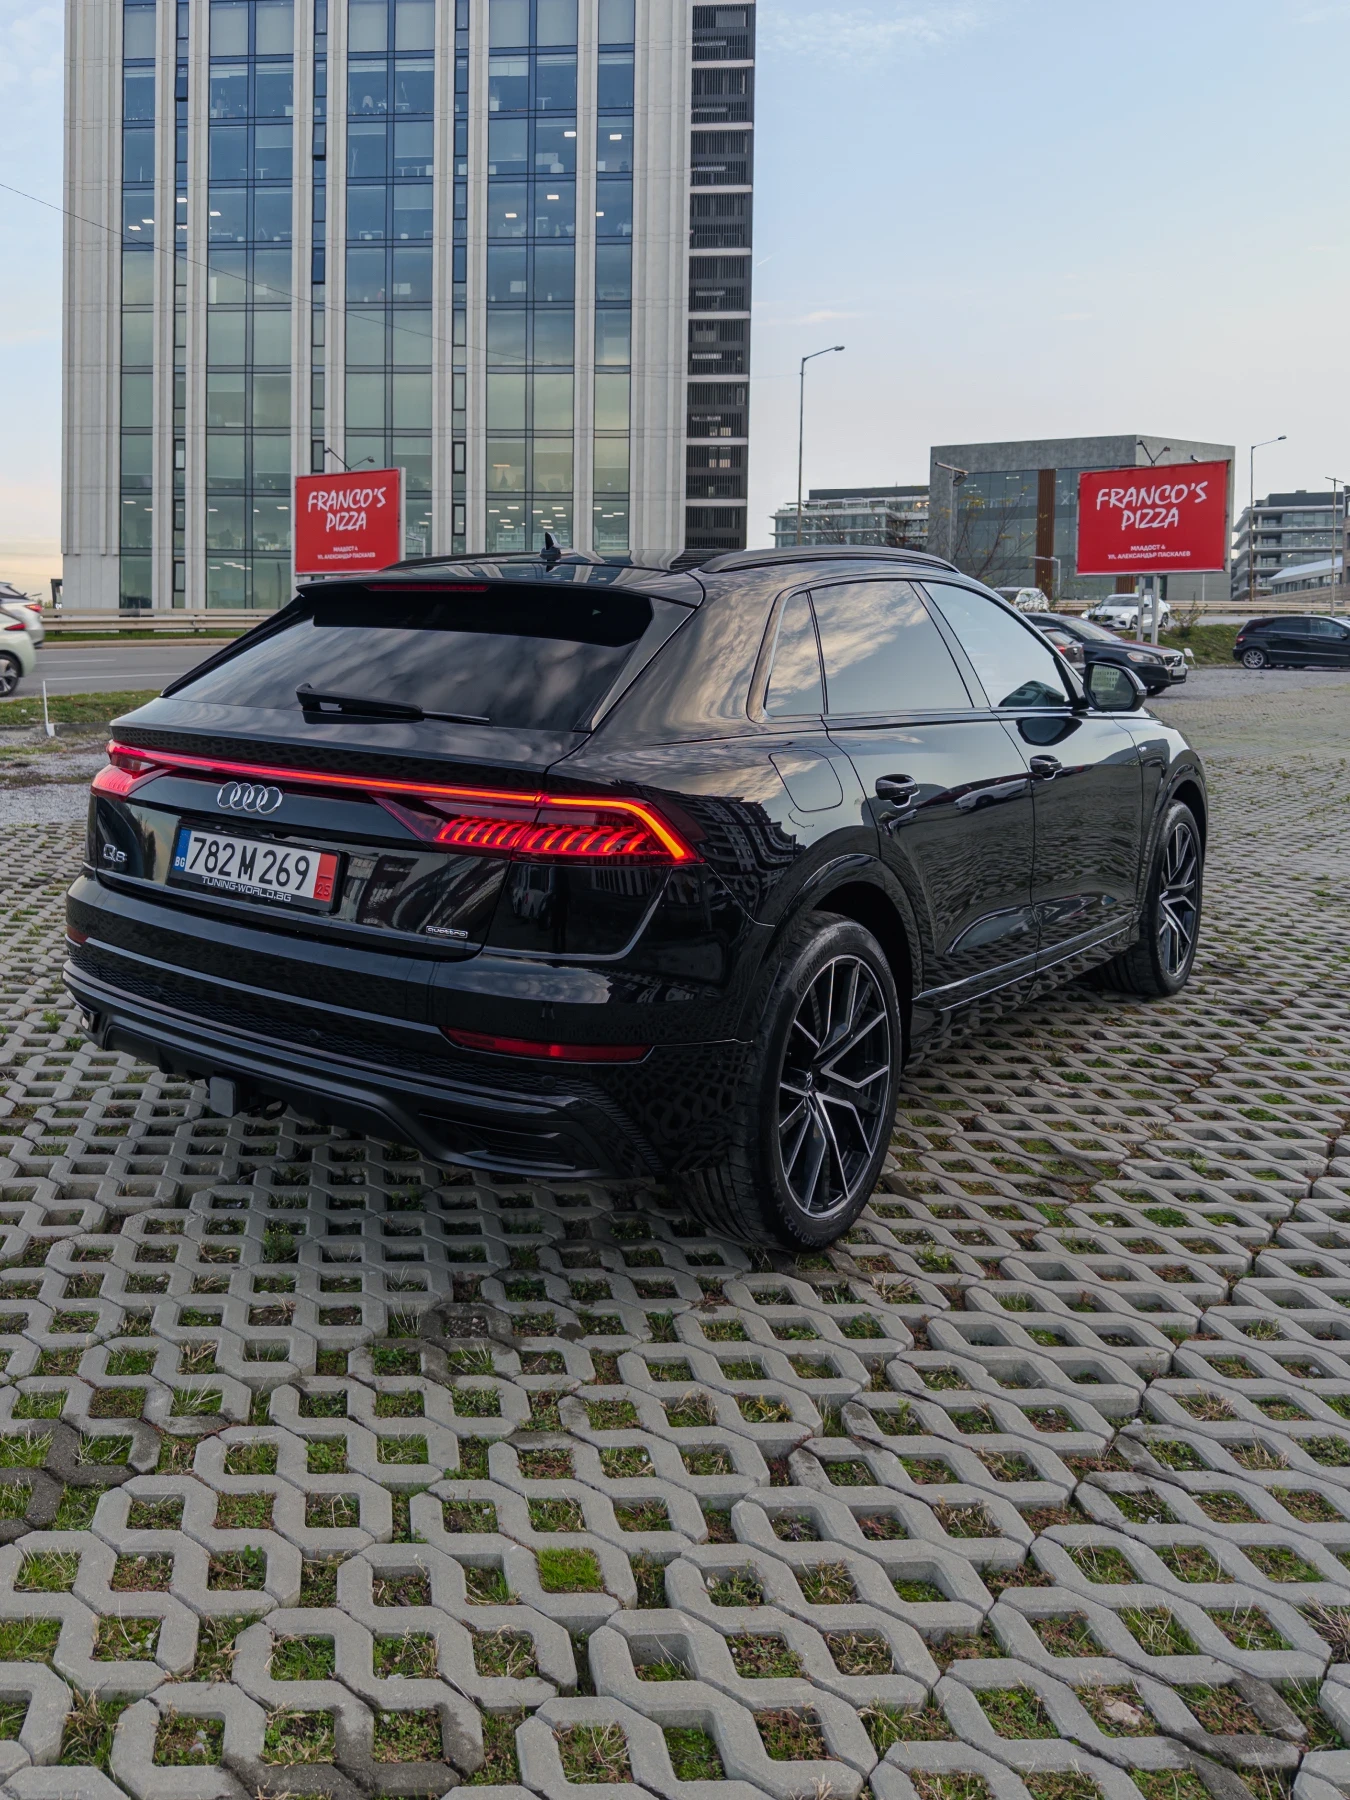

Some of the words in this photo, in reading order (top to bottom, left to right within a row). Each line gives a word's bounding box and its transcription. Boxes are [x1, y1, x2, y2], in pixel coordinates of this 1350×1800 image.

[307, 487, 387, 513] FRANCO'S
[1096, 481, 1208, 510] FRANCO'S
[326, 511, 366, 532] PIZZA
[1122, 507, 1178, 530] PIZZA
[103, 843, 127, 863] Q8
[174, 856, 185, 868] BG
[189, 836, 236, 877] 782
[237, 845, 258, 882] M
[258, 849, 310, 891] 269
[202, 875, 292, 902] TUNING-WORLD.BG
[427, 927, 466, 937] quattro
